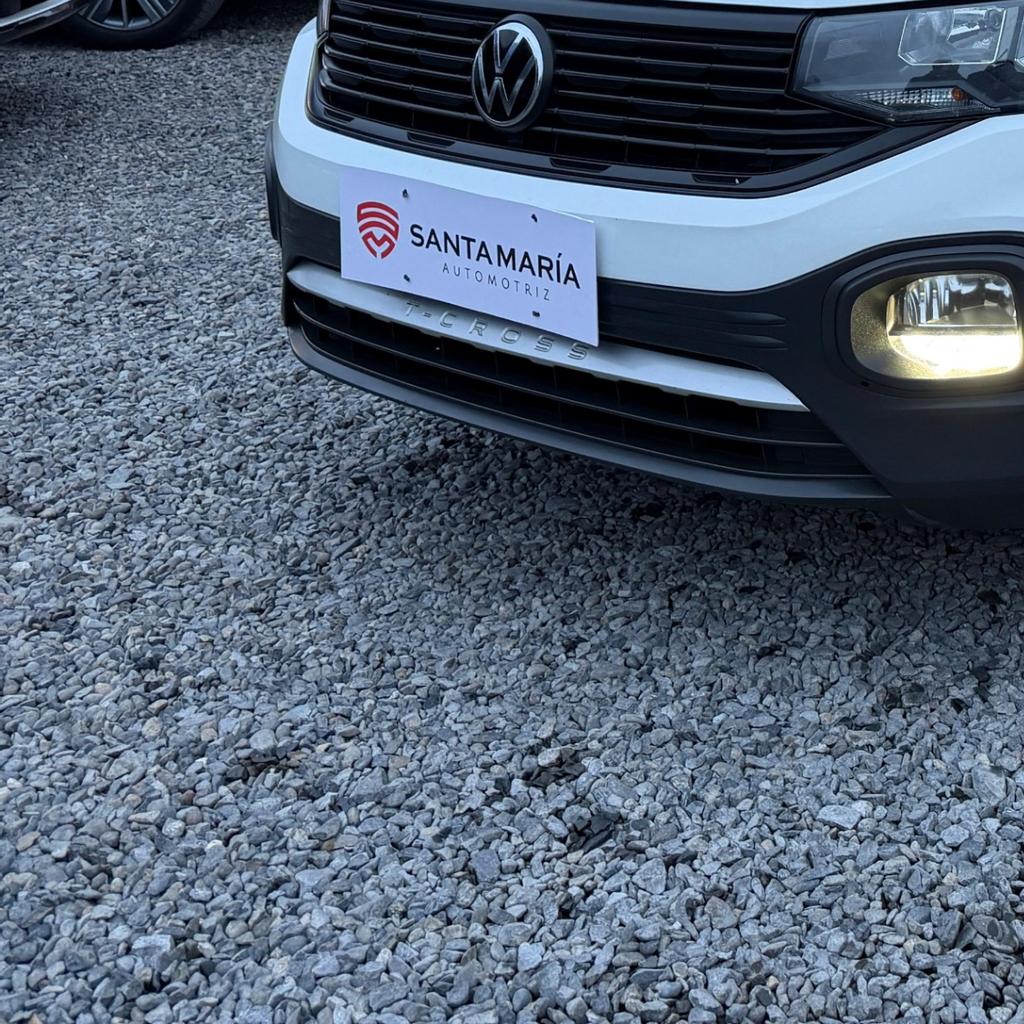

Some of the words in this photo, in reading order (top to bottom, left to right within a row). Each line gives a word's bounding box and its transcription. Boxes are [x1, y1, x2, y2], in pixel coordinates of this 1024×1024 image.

[475, 25, 541, 123] VW
[409, 223, 581, 289] SANTAMARÍA
[442, 262, 551, 301] AUTOMOTRIZ
[404, 301, 591, 361] T-CROSS
